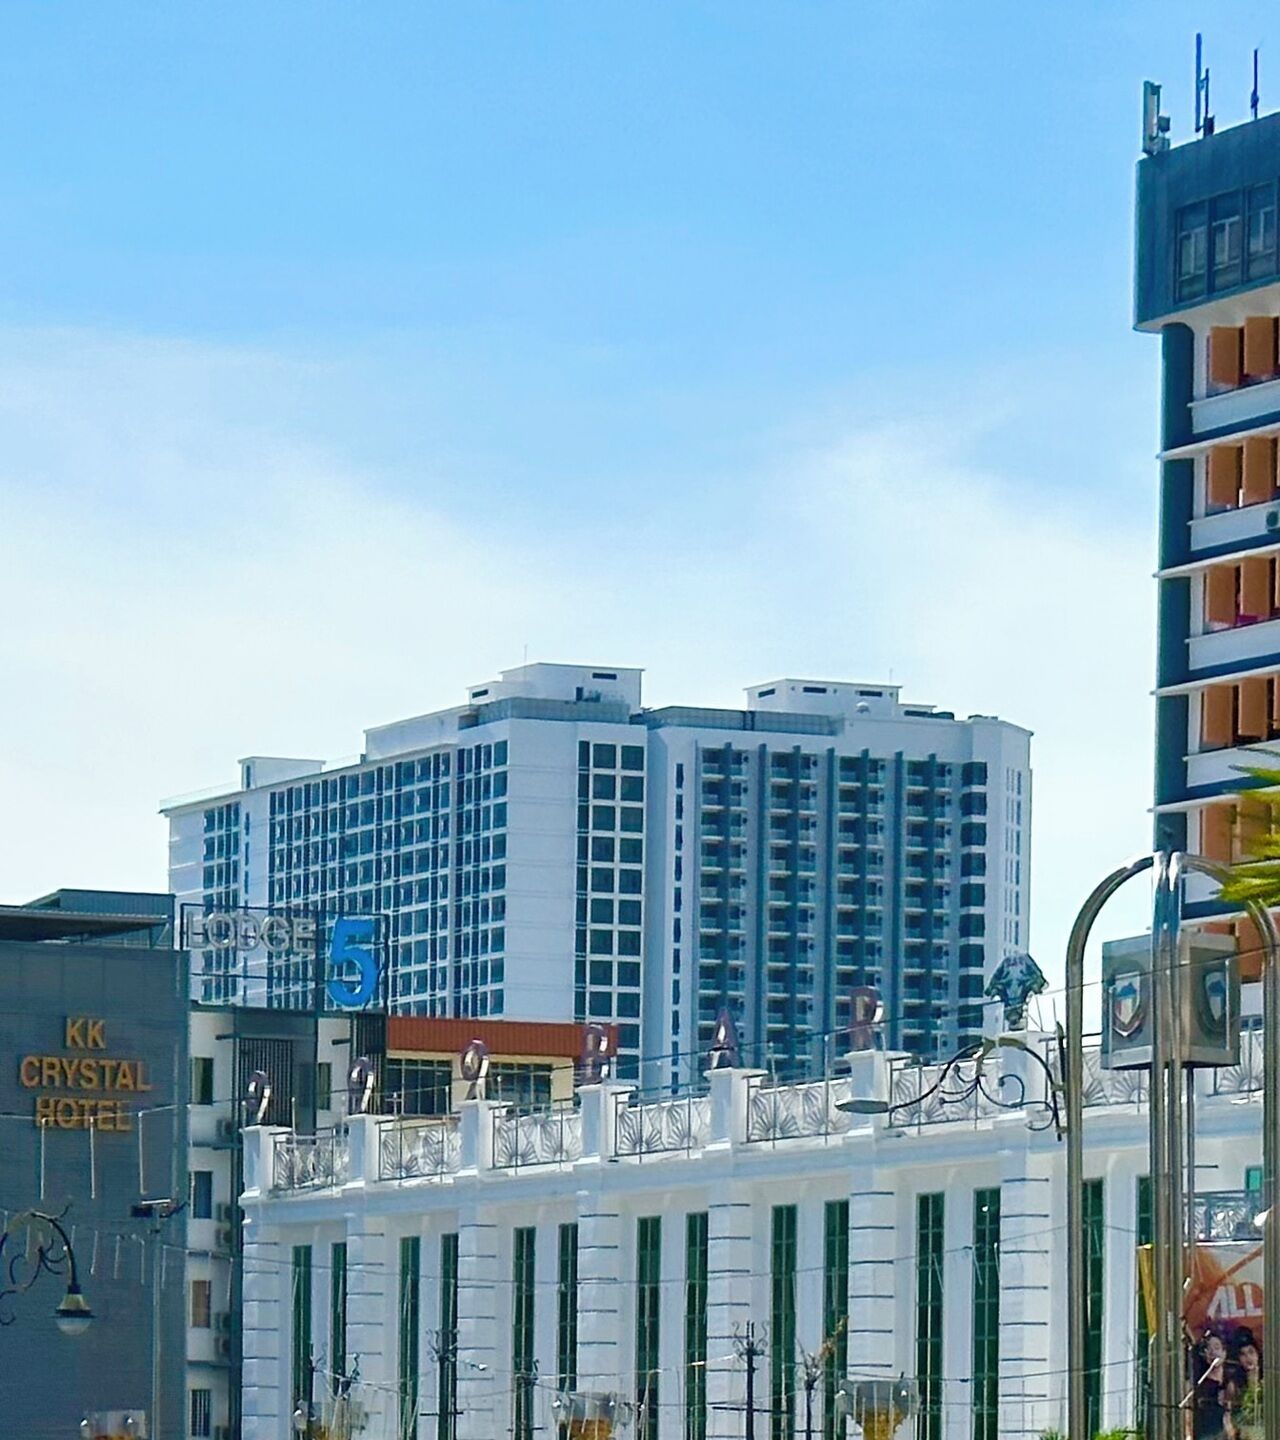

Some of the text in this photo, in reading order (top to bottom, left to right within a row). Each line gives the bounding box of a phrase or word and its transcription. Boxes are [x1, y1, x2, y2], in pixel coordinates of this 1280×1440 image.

[187, 911, 378, 1006] LODGE 5
[65, 1018, 107, 1049] KK
[20, 1056, 152, 1091] CRYSTAL
[35, 1097, 133, 1131] HOTEL
